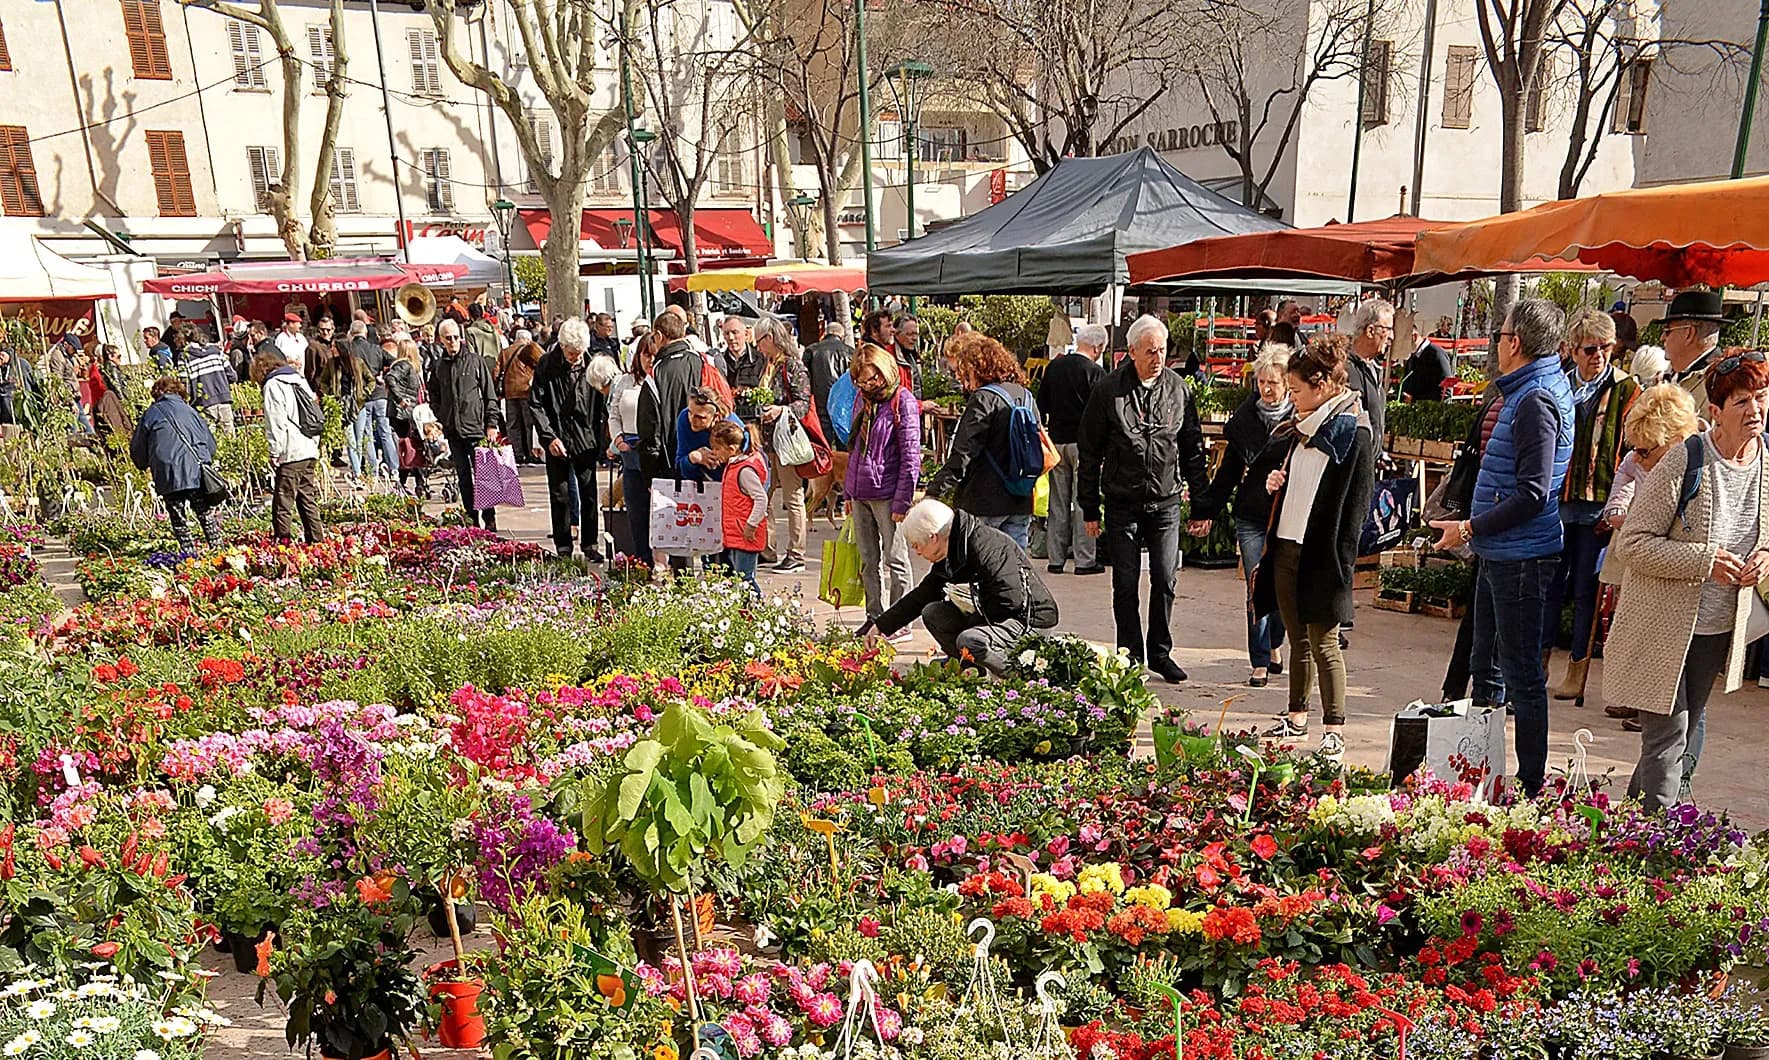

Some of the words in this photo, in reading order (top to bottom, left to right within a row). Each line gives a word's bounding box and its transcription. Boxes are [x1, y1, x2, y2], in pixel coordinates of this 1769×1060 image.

[421, 222, 486, 244] Casin
[171, 284, 219, 293] CHICHI
[277, 281, 370, 293] CHURROS
